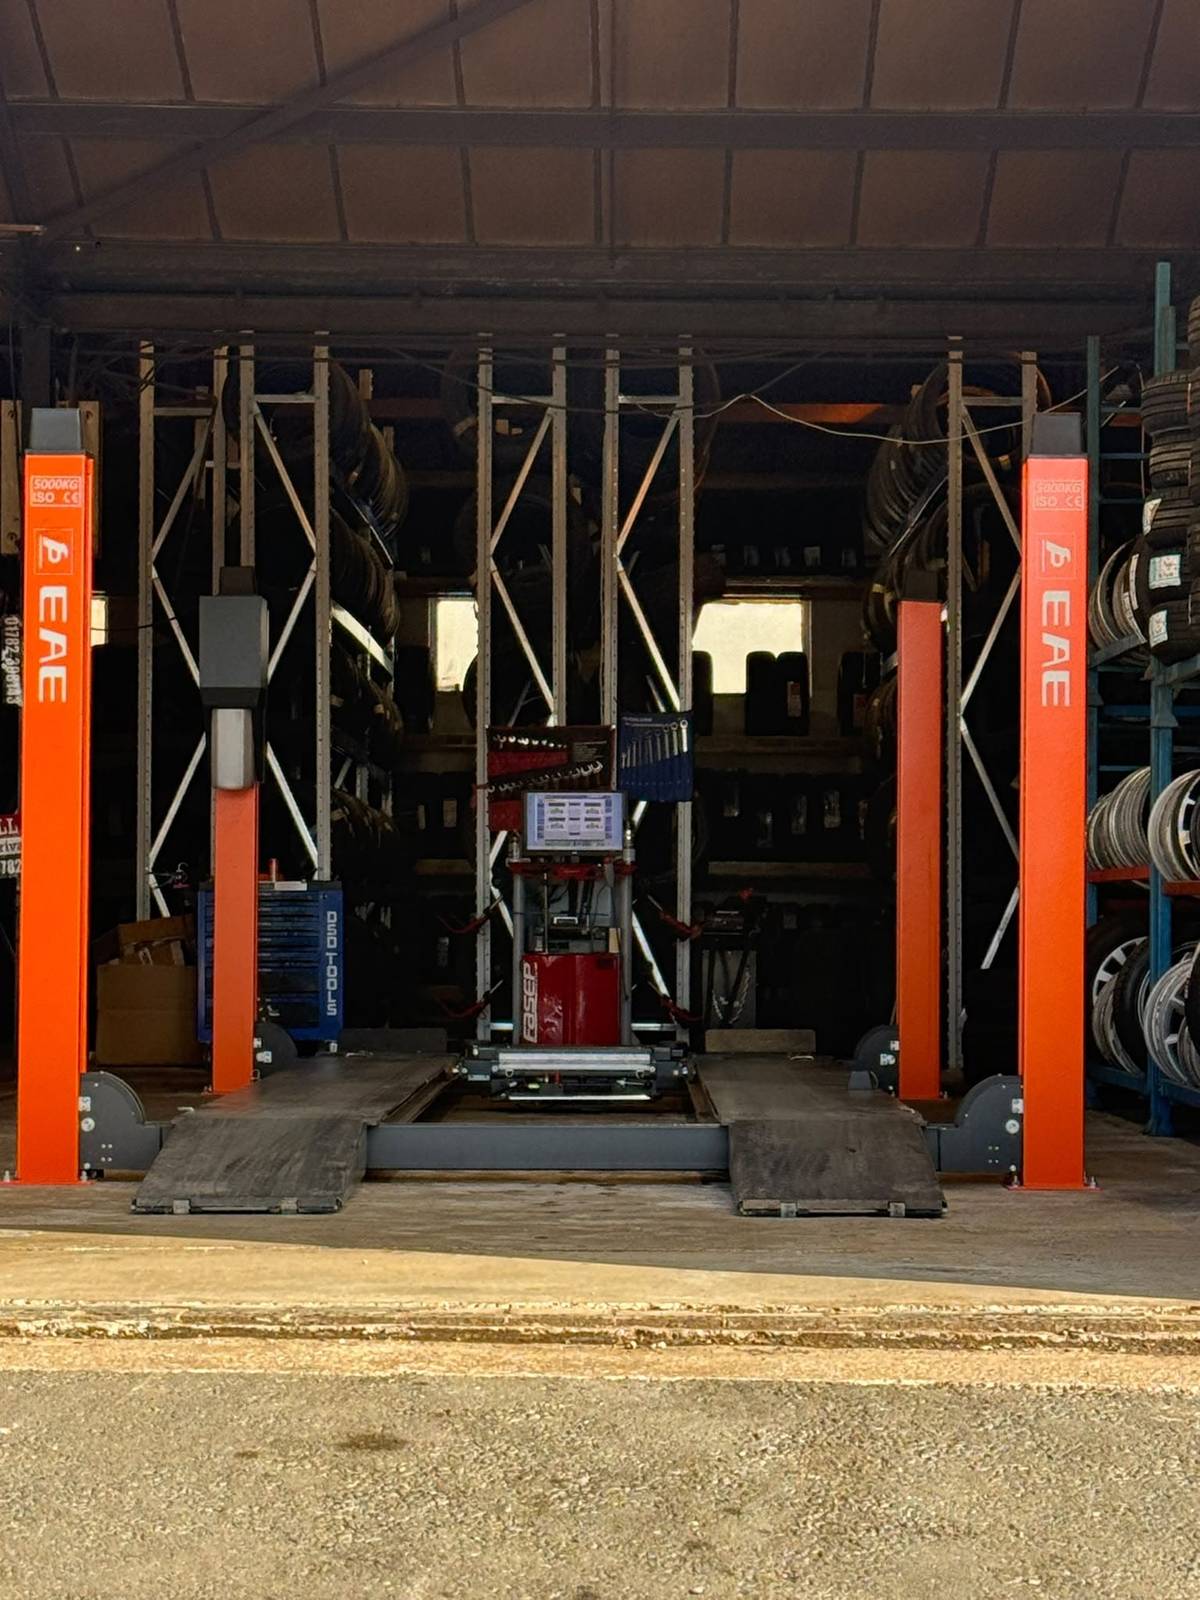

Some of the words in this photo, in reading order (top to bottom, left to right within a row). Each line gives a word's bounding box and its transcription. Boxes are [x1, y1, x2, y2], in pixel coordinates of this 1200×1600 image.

[33, 478, 79, 491] 5000KG
[1035, 482, 1081, 494] 5000KG
[33, 492, 55, 503] ISO
[1036, 495, 1057, 507] ISO
[39, 586, 67, 703] EAE
[1042, 590, 1070, 707] EAE
[325, 952, 338, 1017] TOOLS
